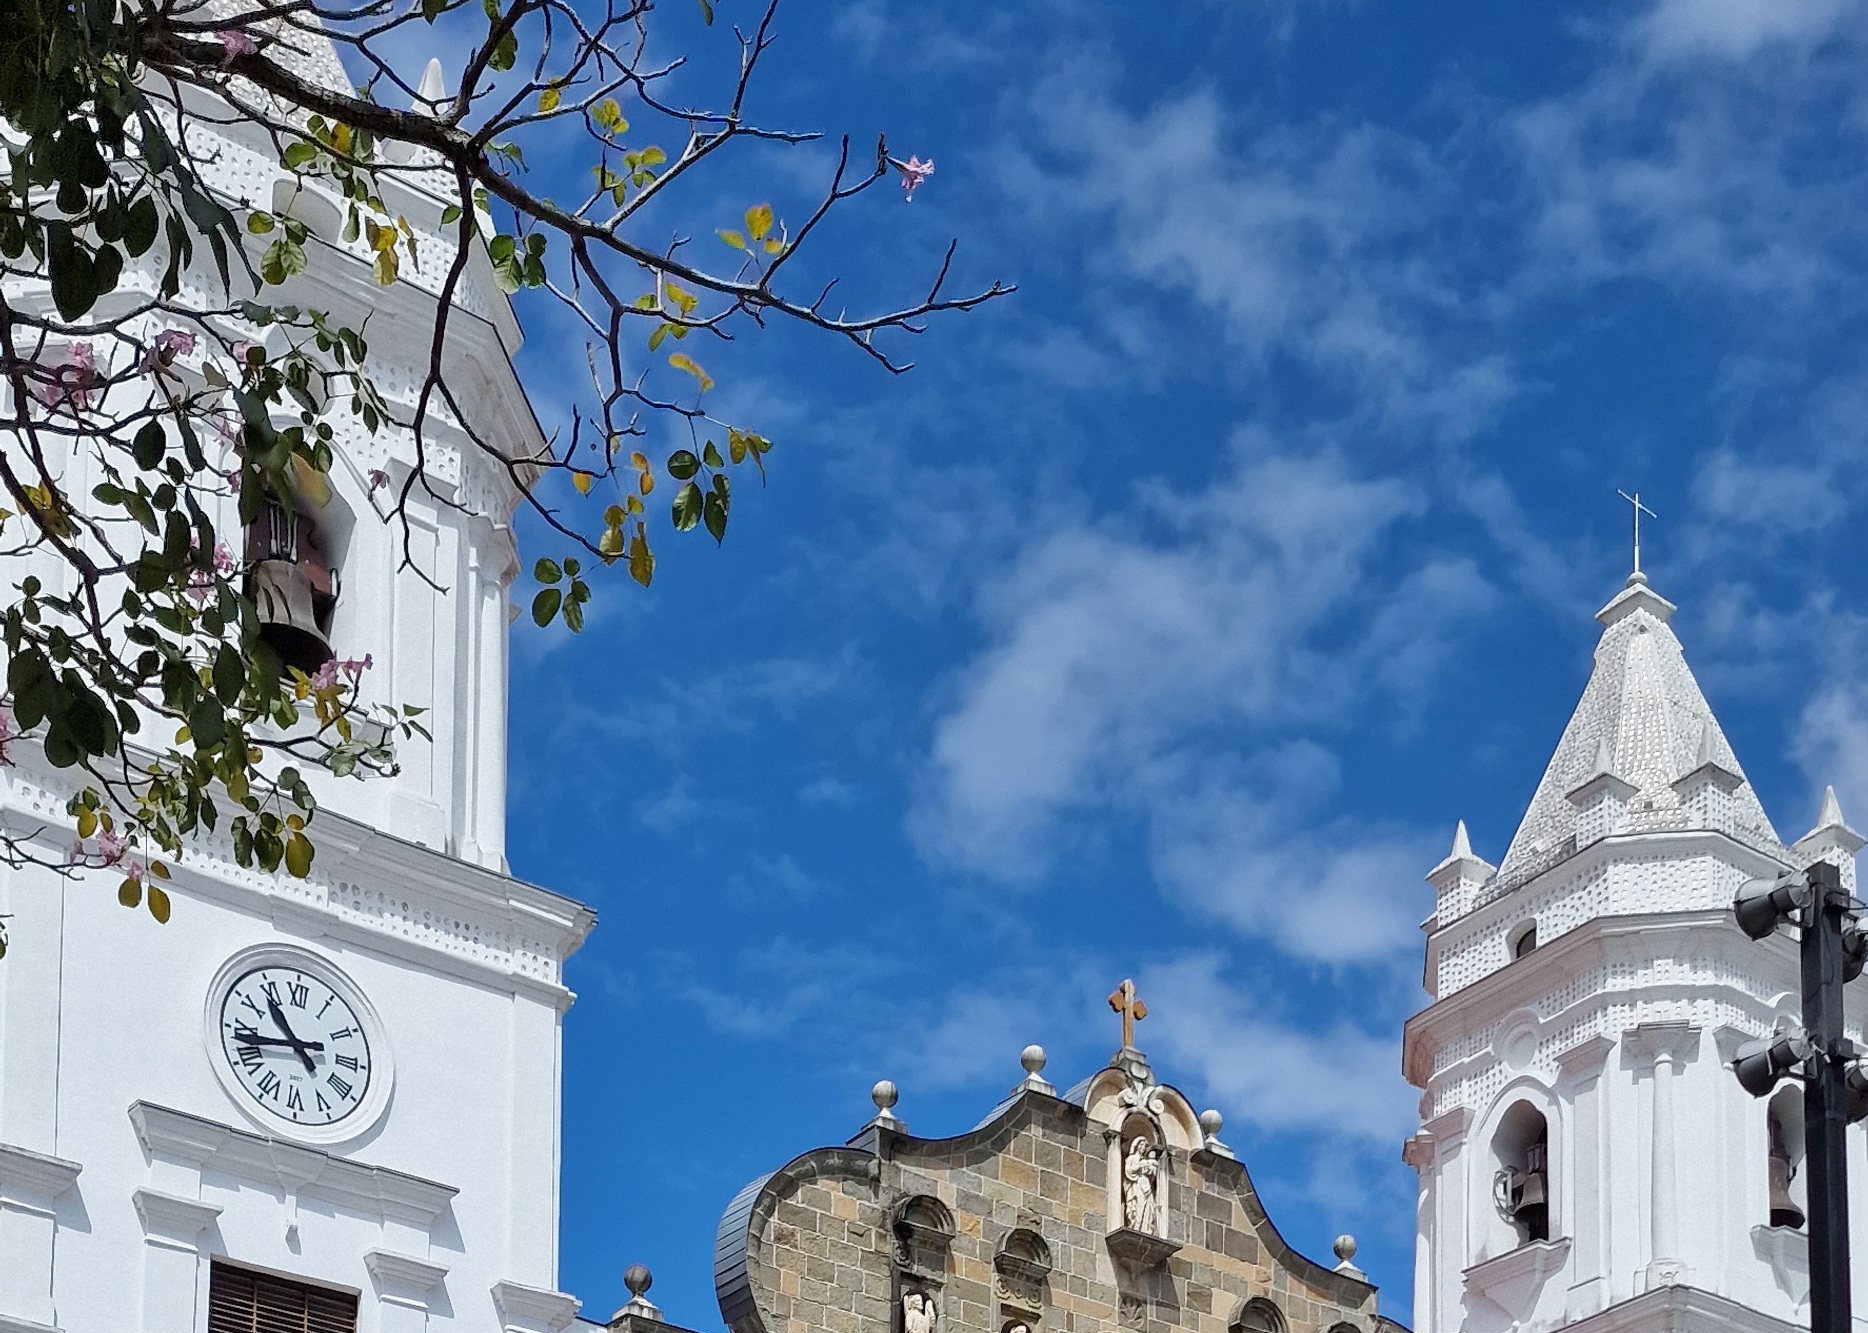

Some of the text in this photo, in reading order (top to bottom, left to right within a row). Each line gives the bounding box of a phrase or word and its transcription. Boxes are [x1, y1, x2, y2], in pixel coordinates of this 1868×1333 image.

[241, 994, 266, 1019] X
[287, 981, 310, 1010] XII
[315, 999, 332, 1020] I
[330, 1026, 353, 1042] II
[236, 1046, 265, 1077] VIII
[335, 1052, 359, 1074] III
[256, 1069, 281, 1101] VII
[286, 1084, 304, 1112] VI
[315, 1088, 332, 1112] V
